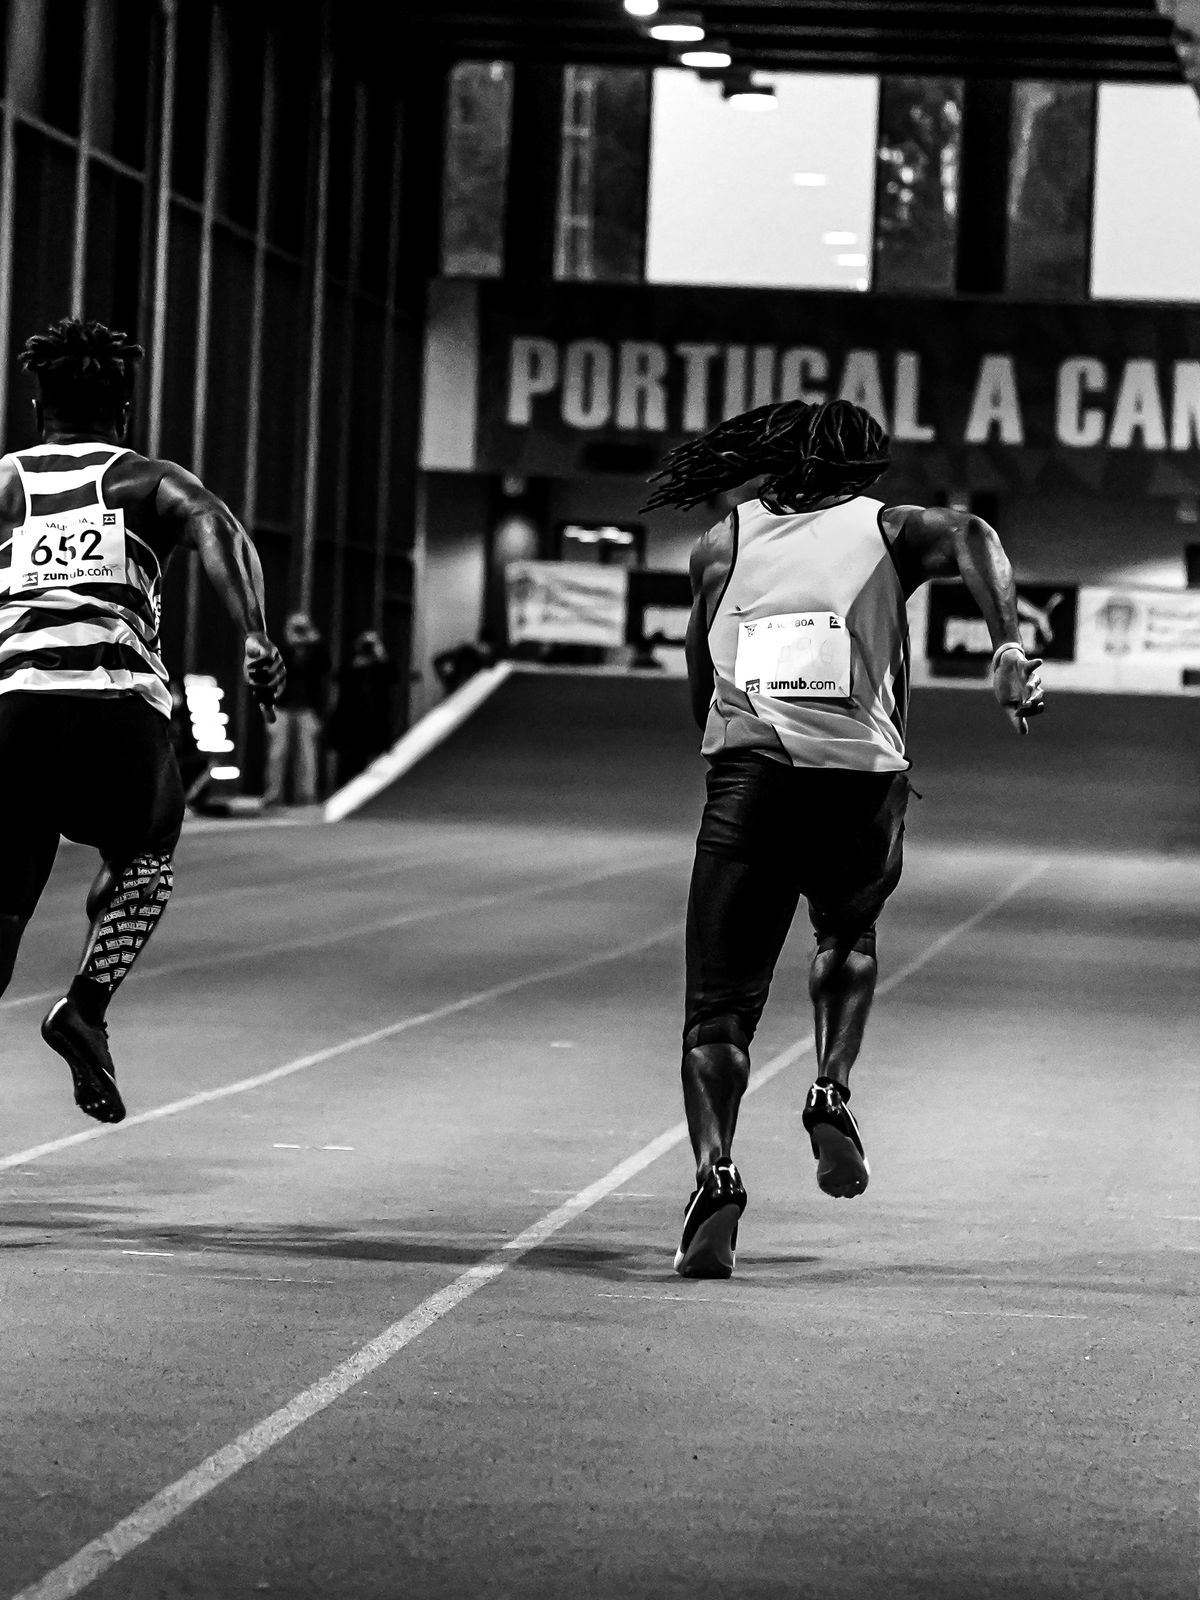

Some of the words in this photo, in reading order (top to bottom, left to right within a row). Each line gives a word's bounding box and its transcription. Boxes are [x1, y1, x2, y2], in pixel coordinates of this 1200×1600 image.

[963, 353, 1025, 444] A
[30, 529, 105, 567] 652
[42, 567, 113, 581] zumub.com
[766, 677, 836, 690] zumub.com
